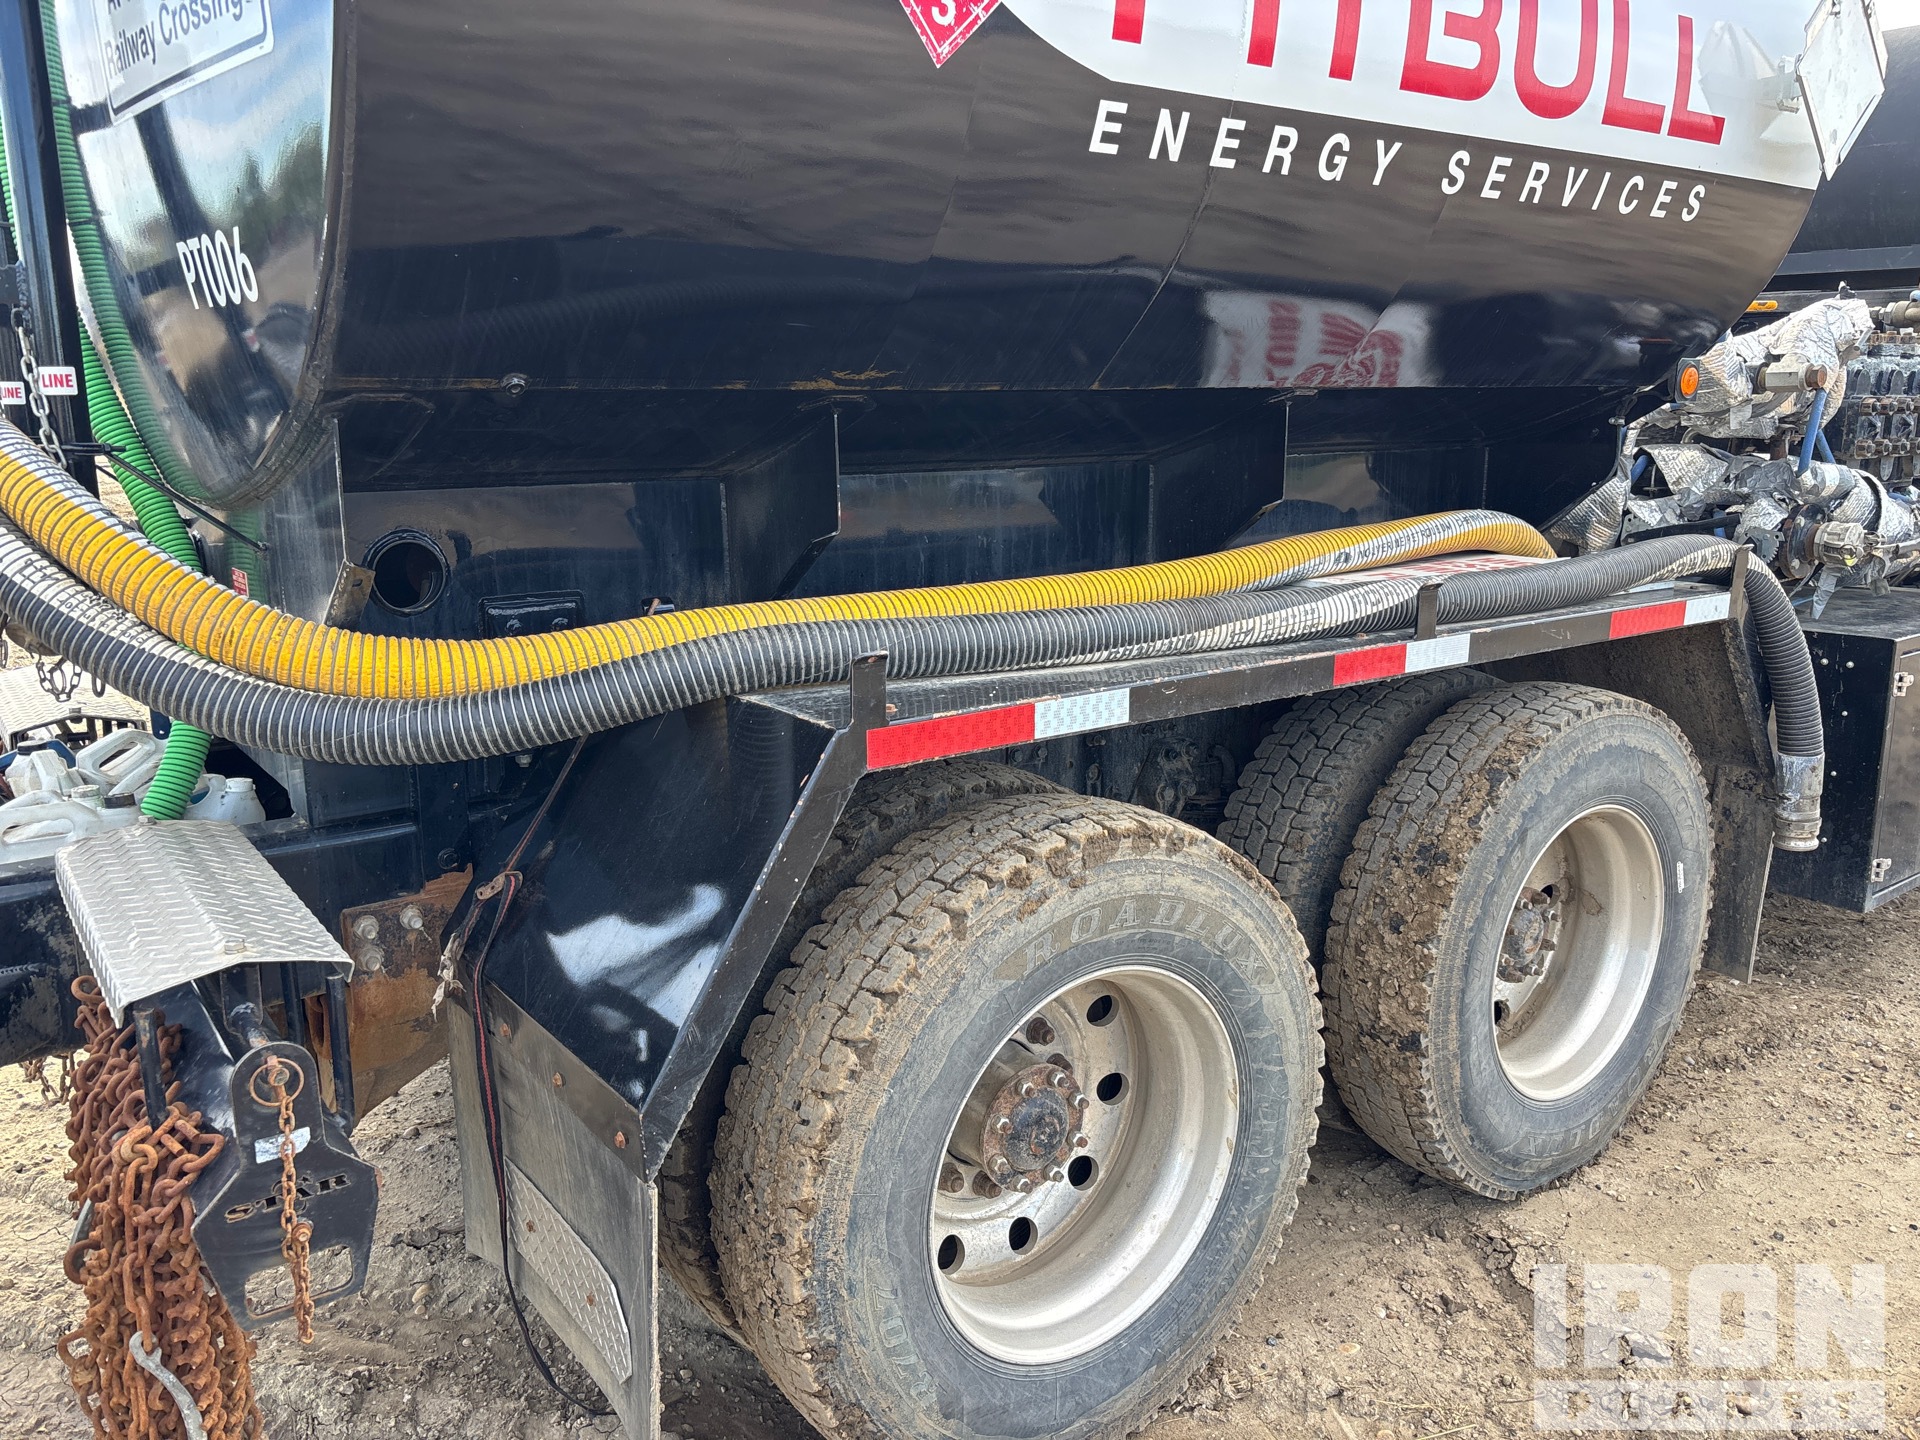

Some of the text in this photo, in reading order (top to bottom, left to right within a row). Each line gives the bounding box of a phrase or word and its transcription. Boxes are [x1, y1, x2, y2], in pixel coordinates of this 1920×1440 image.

[104, 0, 252, 79] Railway Crossing
[1088, 99, 1707, 223] ENERGY SERVICES
[176, 226, 259, 310] PT006
[1, 386, 23, 399] INE
[41, 373, 74, 388] LINE
[1021, 899, 1269, 978] ROADLUX
